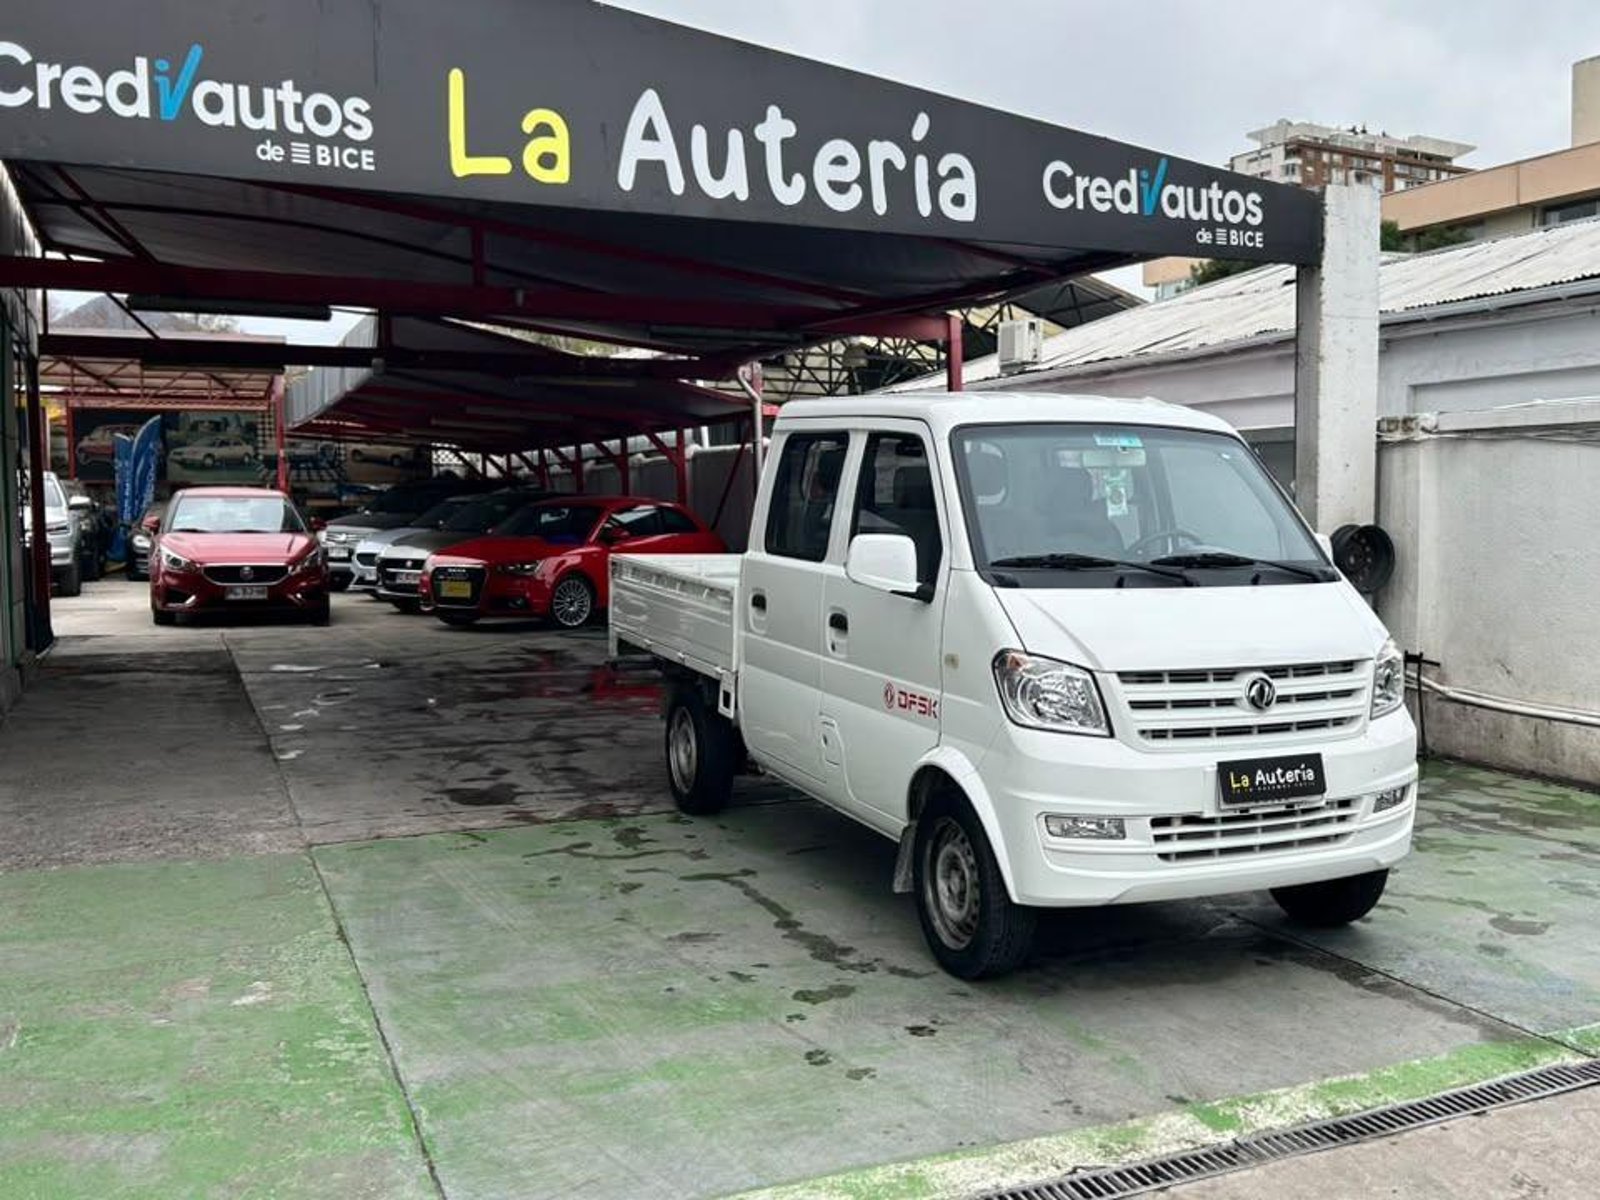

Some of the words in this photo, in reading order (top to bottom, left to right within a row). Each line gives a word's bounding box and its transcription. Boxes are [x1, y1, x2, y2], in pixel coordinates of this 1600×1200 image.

[256, 140, 286, 163] de
[315, 145, 376, 171] BICE
[448, 67, 571, 184] La
[617, 88, 977, 222] Autería
[1196, 228, 1213, 244] de
[1229, 229, 1264, 248] BICE
[897, 690, 938, 719] DFSK
[1230, 771, 1250, 789] La
[1255, 763, 1315, 786] Autería
